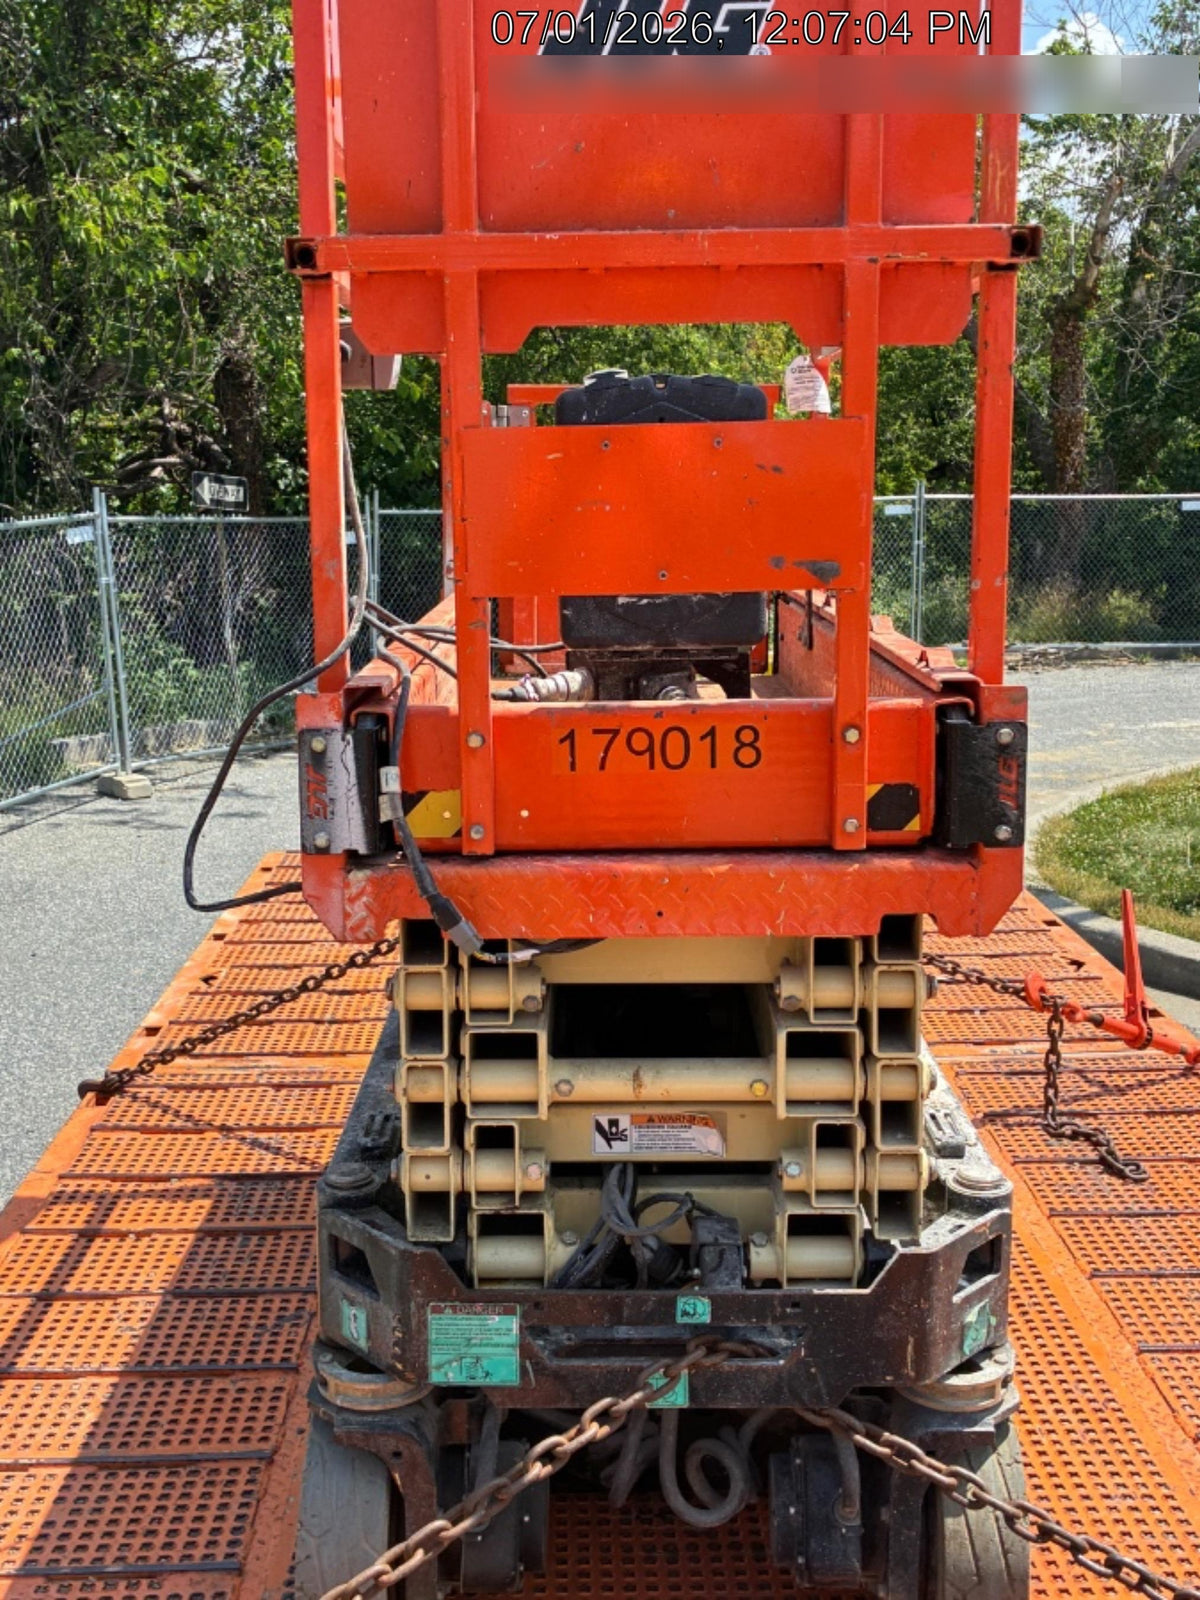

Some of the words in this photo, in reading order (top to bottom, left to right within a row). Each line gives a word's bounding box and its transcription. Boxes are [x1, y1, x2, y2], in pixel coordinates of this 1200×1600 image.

[558, 725, 762, 772] 179018
[305, 763, 328, 820] JLG
[997, 757, 1019, 811] JLG
[456, 1305, 504, 1314] DANGER
